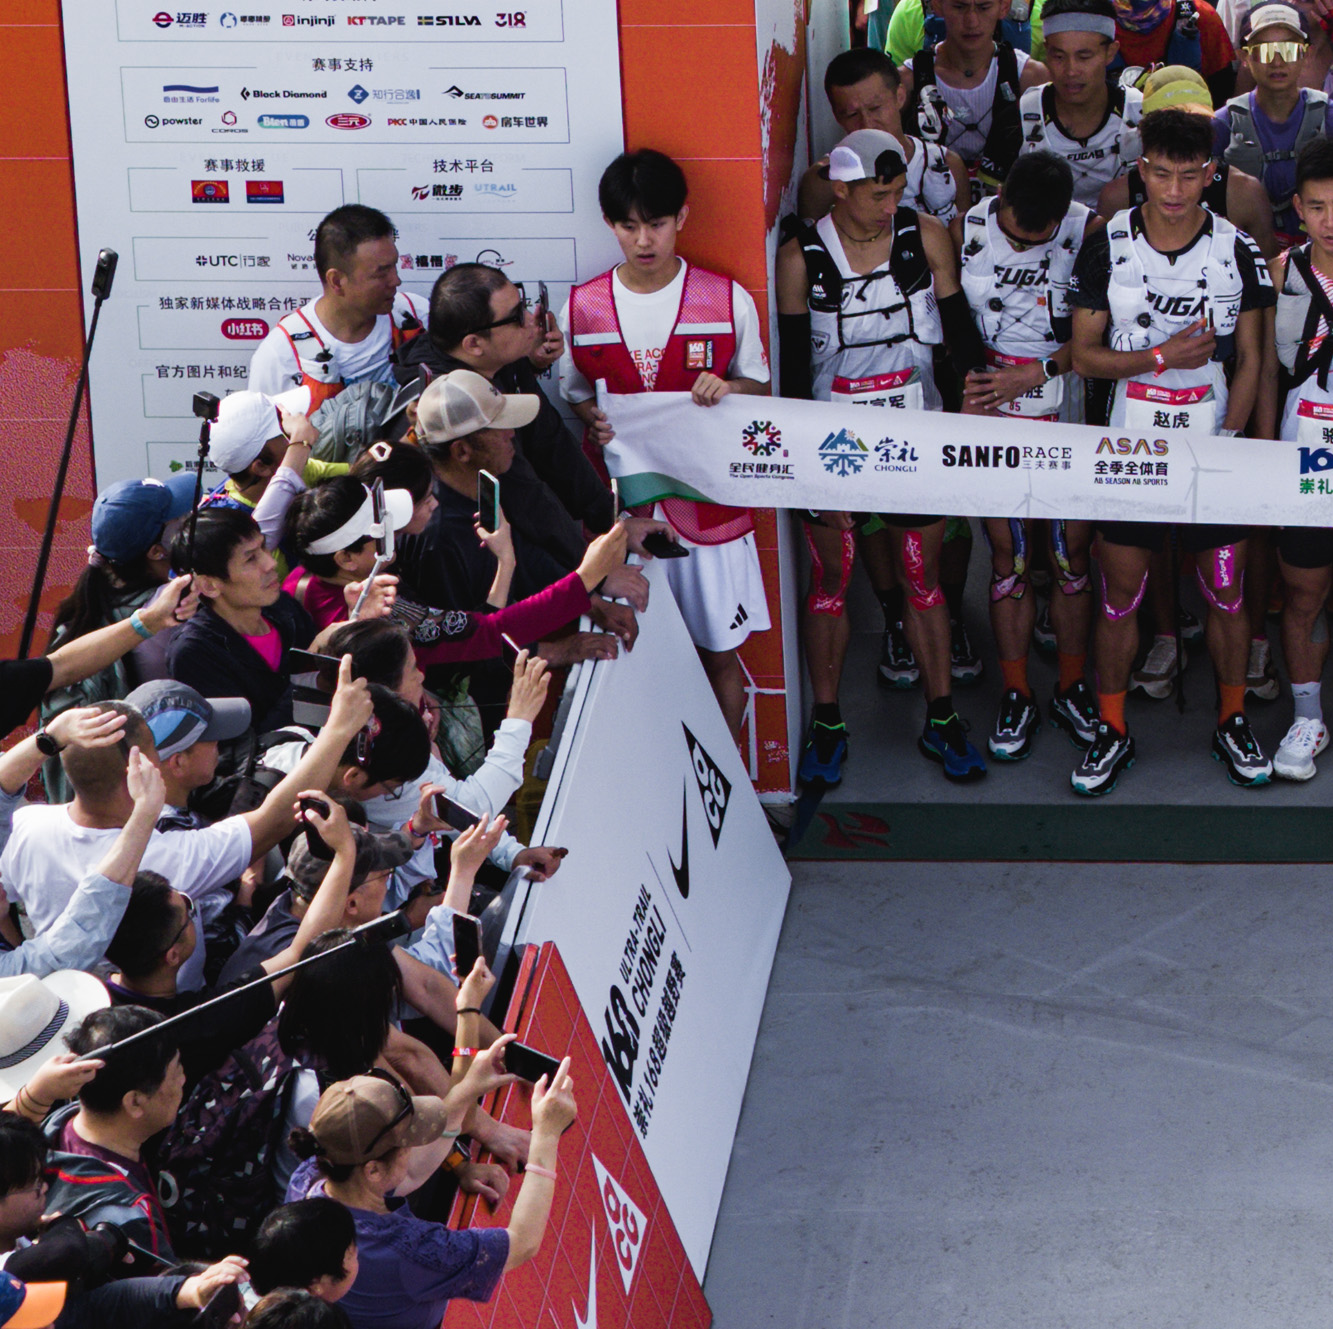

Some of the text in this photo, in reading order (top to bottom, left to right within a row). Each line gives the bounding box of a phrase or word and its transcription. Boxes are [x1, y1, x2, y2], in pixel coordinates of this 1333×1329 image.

[176, 13, 207, 24] 迈胜
[297, 16, 335, 27] injinji
[436, 16, 481, 26] SILVA
[312, 58, 373, 72] 赛事支持
[253, 90, 327, 98] Black Diamond
[162, 117, 202, 126] powster
[501, 117, 548, 127] 房车世界
[204, 159, 264, 172] 赛事救援
[433, 159, 493, 173] 技术平台
[475, 184, 517, 192] UTRAIL
[209, 255, 238, 267] UTC
[228, 323, 263, 335] 小红书
[1007, 401, 1021, 412] 85
[1153, 410, 1190, 429] 赵虎
[942, 445, 1020, 468] SANFO
[1022, 447, 1072, 459] RACE
[729, 463, 794, 476] 全民健身汇
[874, 464, 917, 472] CHONGLI
[1023, 460, 1071, 470] 三夫赛事
[1094, 461, 1168, 476] 全季全体育
[1105, 477, 1130, 485] SEASON
[619, 883, 652, 985] ULTRA-TRAIL
[631, 904, 668, 1018] CHONGLI
